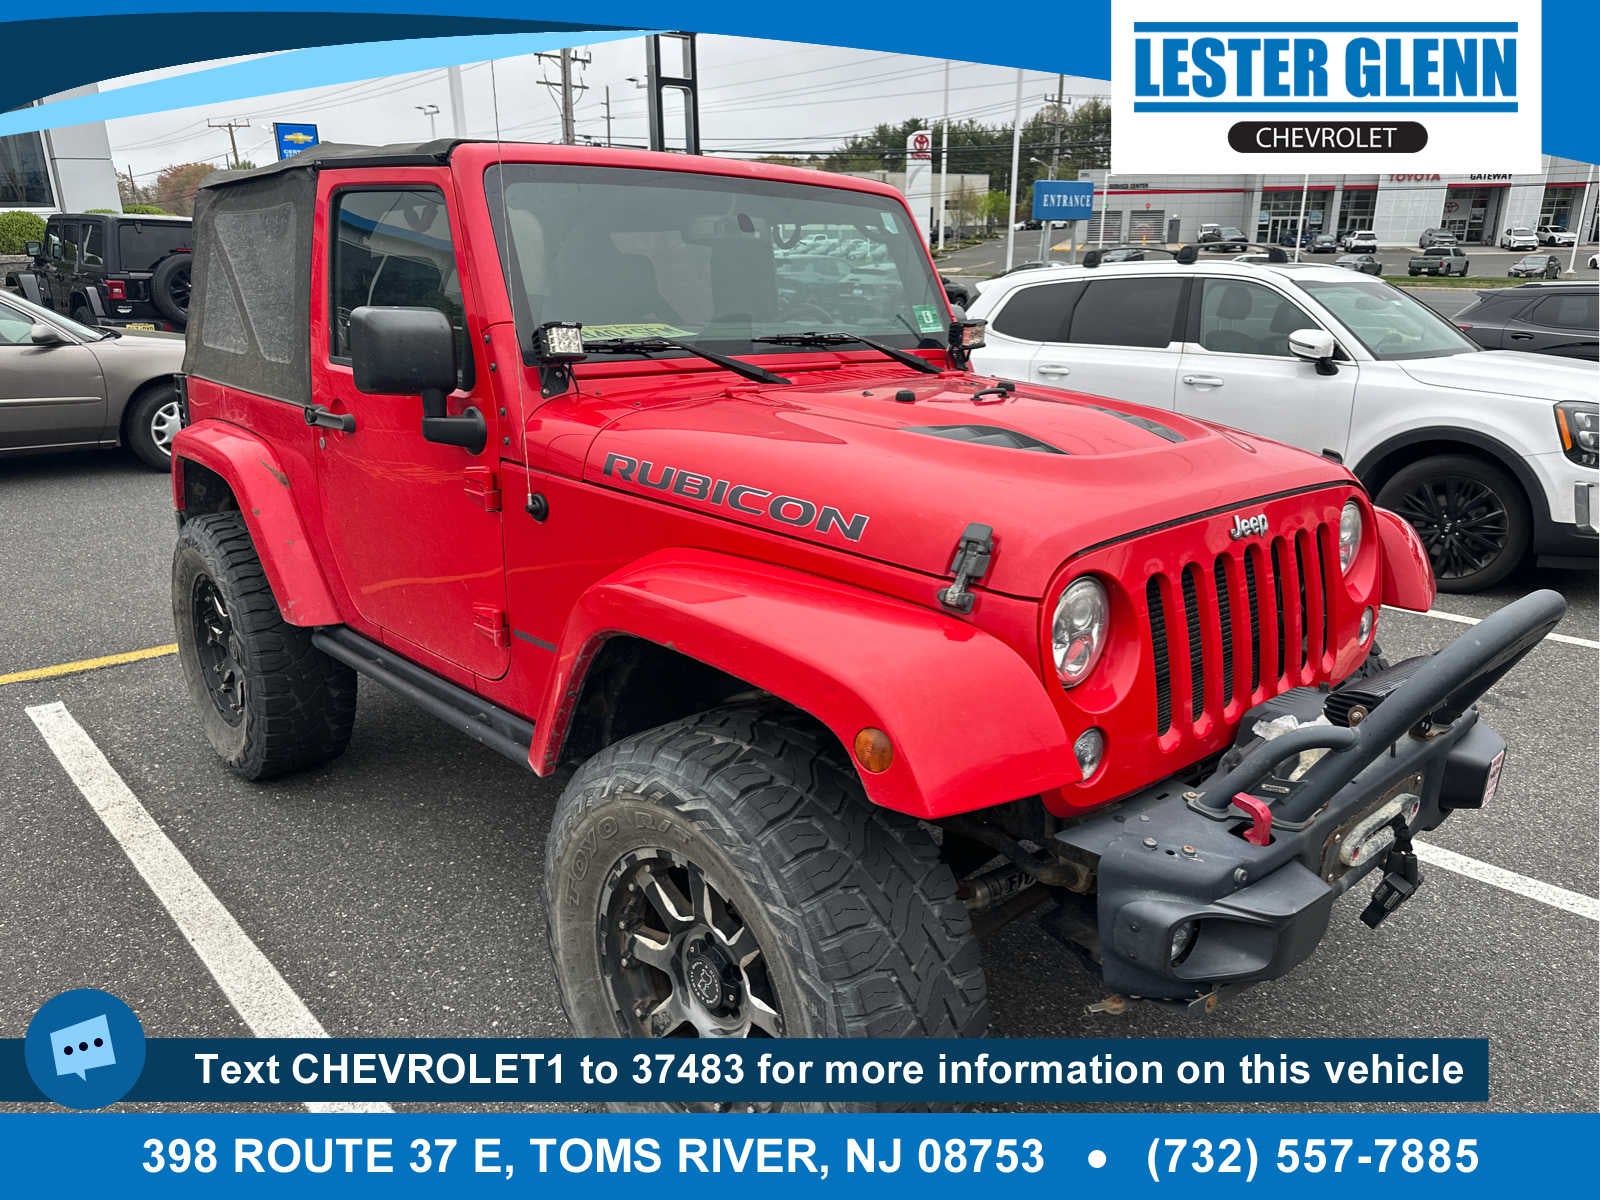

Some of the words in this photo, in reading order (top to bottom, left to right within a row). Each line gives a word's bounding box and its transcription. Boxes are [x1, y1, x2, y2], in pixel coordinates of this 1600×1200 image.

[1389, 173, 1441, 181] TOYOTA
[1469, 173, 1513, 181] GATEWAY
[1043, 194, 1092, 207] ENTRANCE
[602, 452, 871, 542] RUBICON
[1229, 513, 1269, 540] Jeep
